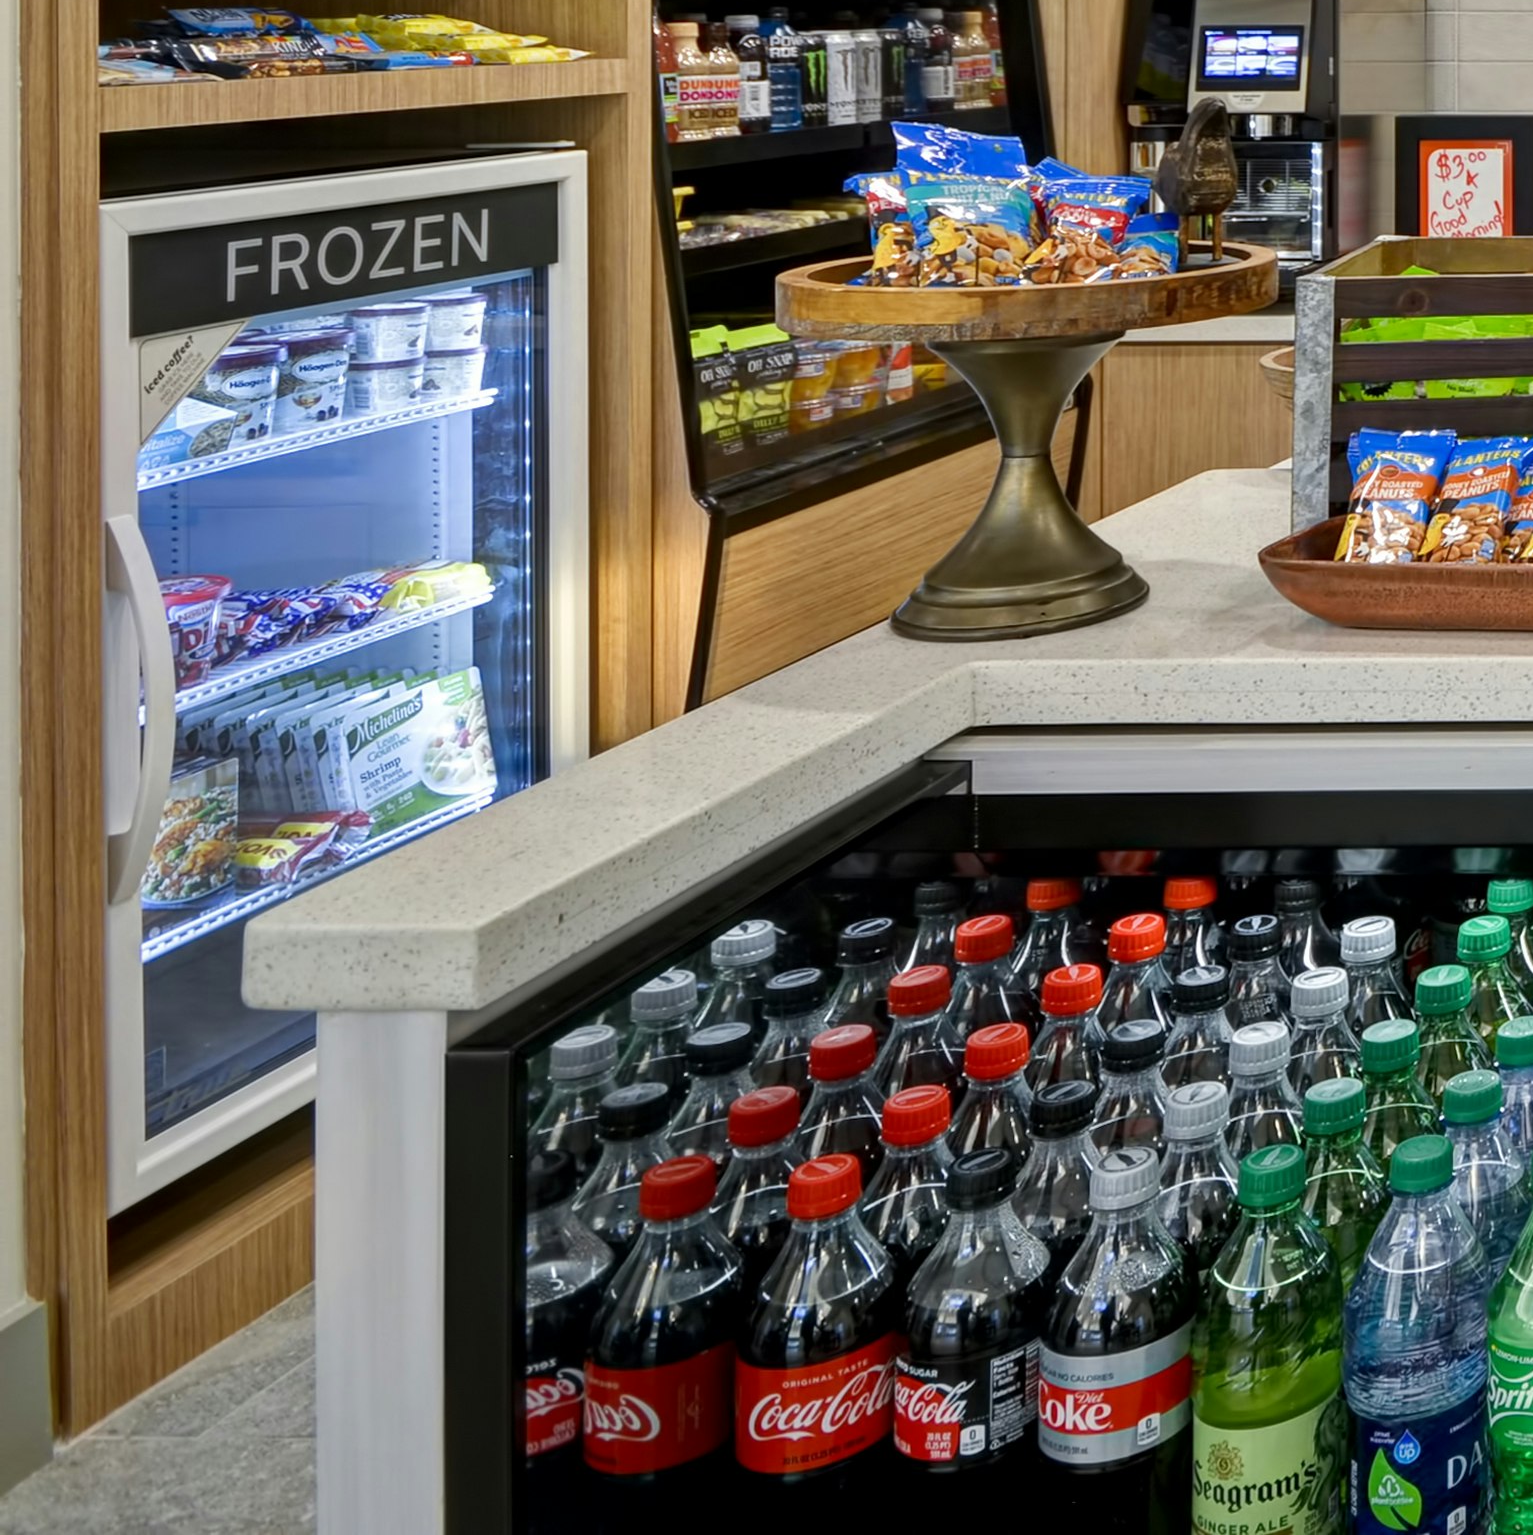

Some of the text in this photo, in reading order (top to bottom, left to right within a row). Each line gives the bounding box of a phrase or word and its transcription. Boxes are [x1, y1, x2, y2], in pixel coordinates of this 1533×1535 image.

[1430, 210, 1467, 236] Good
[226, 209, 489, 302] FROZEN
[144, 369, 165, 395] iced
[164, 334, 195, 374] coffee?
[1444, 480, 1500, 499] PEANUTS
[351, 696, 423, 754] Michelina's
[359, 756, 401, 784] Shrimp
[782, 1358, 870, 1389] ORIGINAL TASTE
[908, 1366, 938, 1378] SUGAR
[1070, 1372, 1114, 1384] CALORIES
[748, 1363, 896, 1442] Coca-Cola
[1074, 1391, 1104, 1405] Diet
[1193, 1459, 1318, 1515] Seagram's
[1197, 1514, 1289, 1535] GINGER ALE
